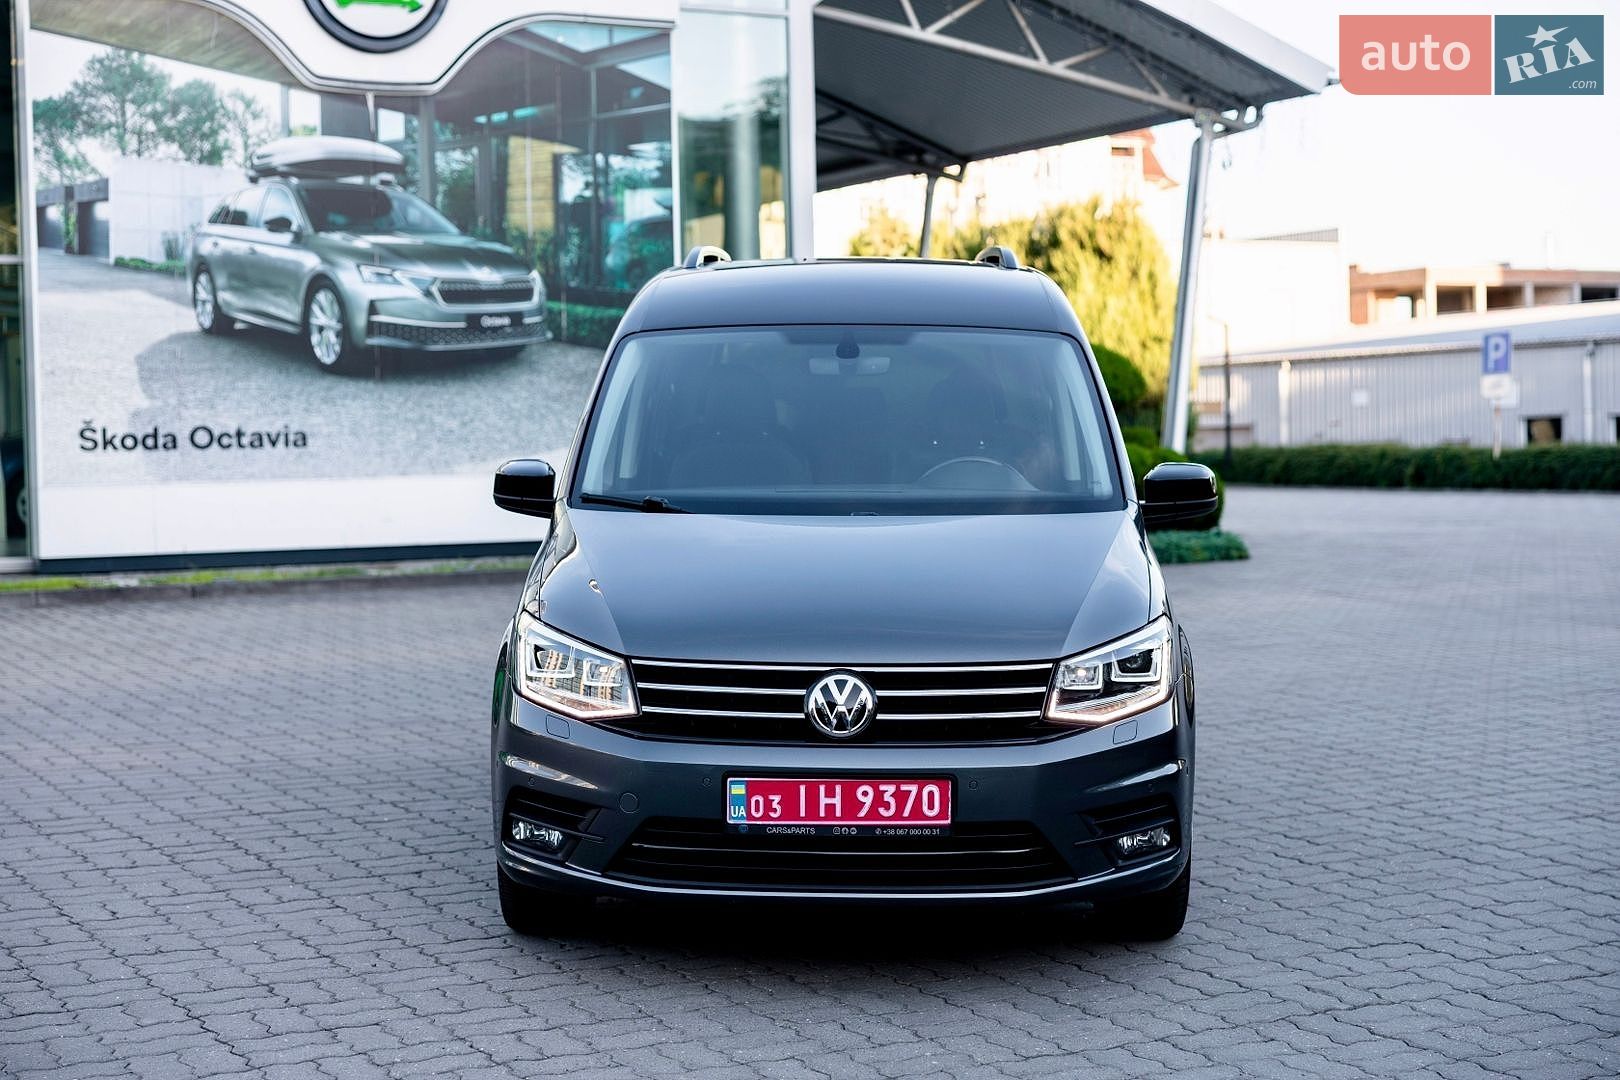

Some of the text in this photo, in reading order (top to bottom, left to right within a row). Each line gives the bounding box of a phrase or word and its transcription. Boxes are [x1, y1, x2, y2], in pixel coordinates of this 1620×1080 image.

[1487, 336, 1507, 373] P
[79, 420, 309, 451] Škoda Octavia
[730, 805, 747, 818] UA
[750, 794, 783, 819] 03
[855, 783, 942, 818] 9370
[766, 826, 816, 836] CARS&PARTS
